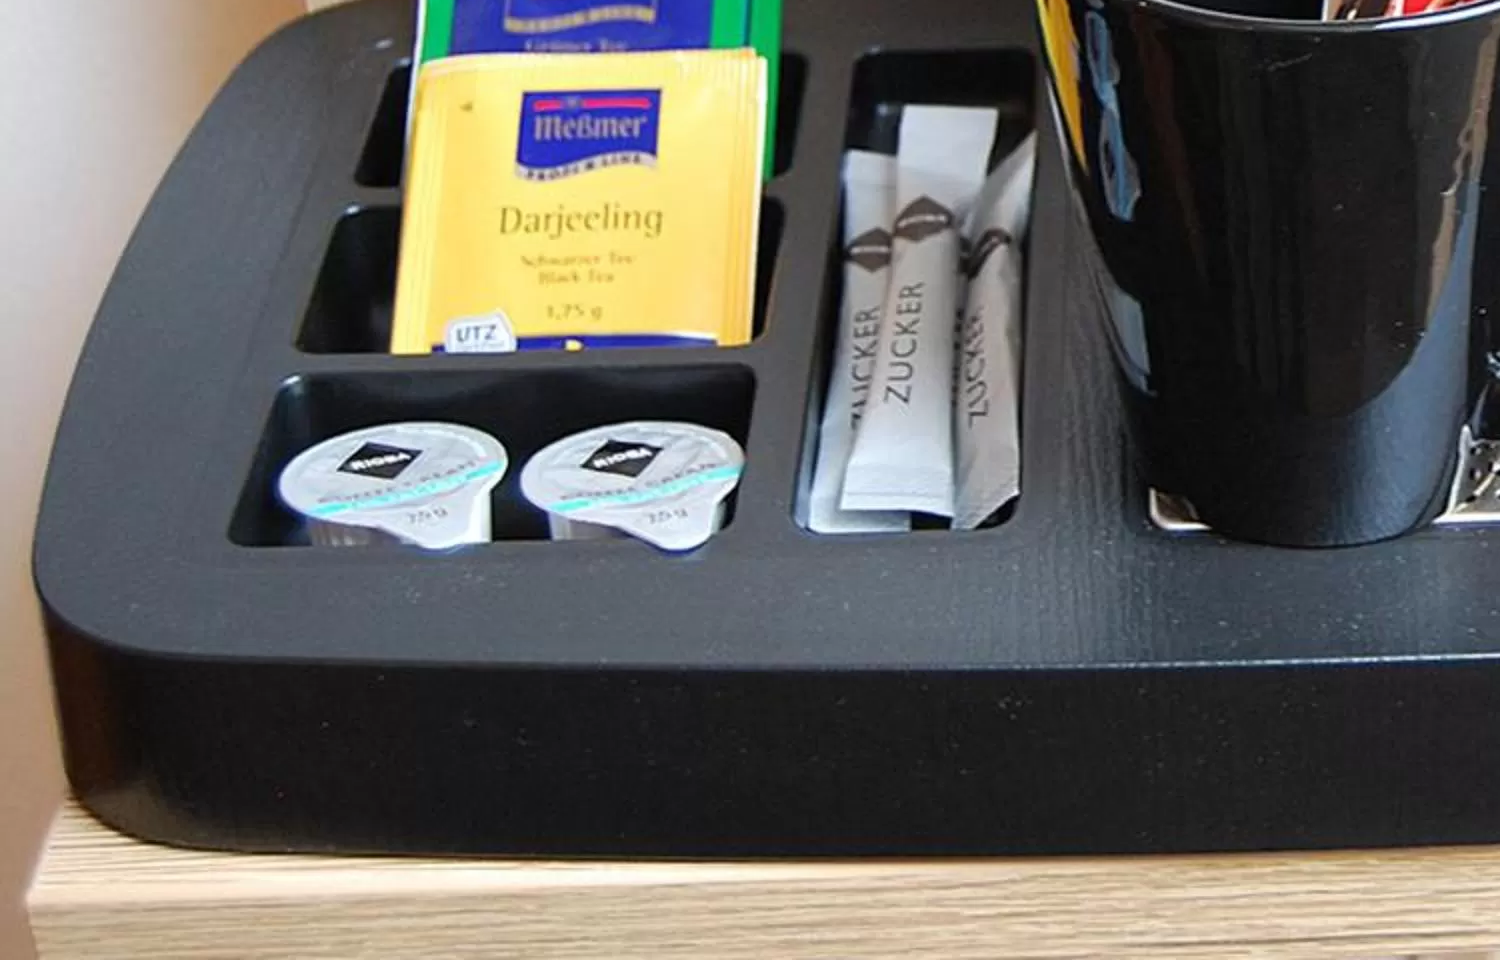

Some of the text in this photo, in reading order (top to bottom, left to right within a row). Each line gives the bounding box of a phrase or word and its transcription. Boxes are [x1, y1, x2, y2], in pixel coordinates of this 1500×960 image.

[533, 114, 647, 141] Meßmer
[499, 203, 664, 240] Darjeeling
[456, 324, 497, 343] UTZ
[884, 281, 925, 406] ZUCKER
